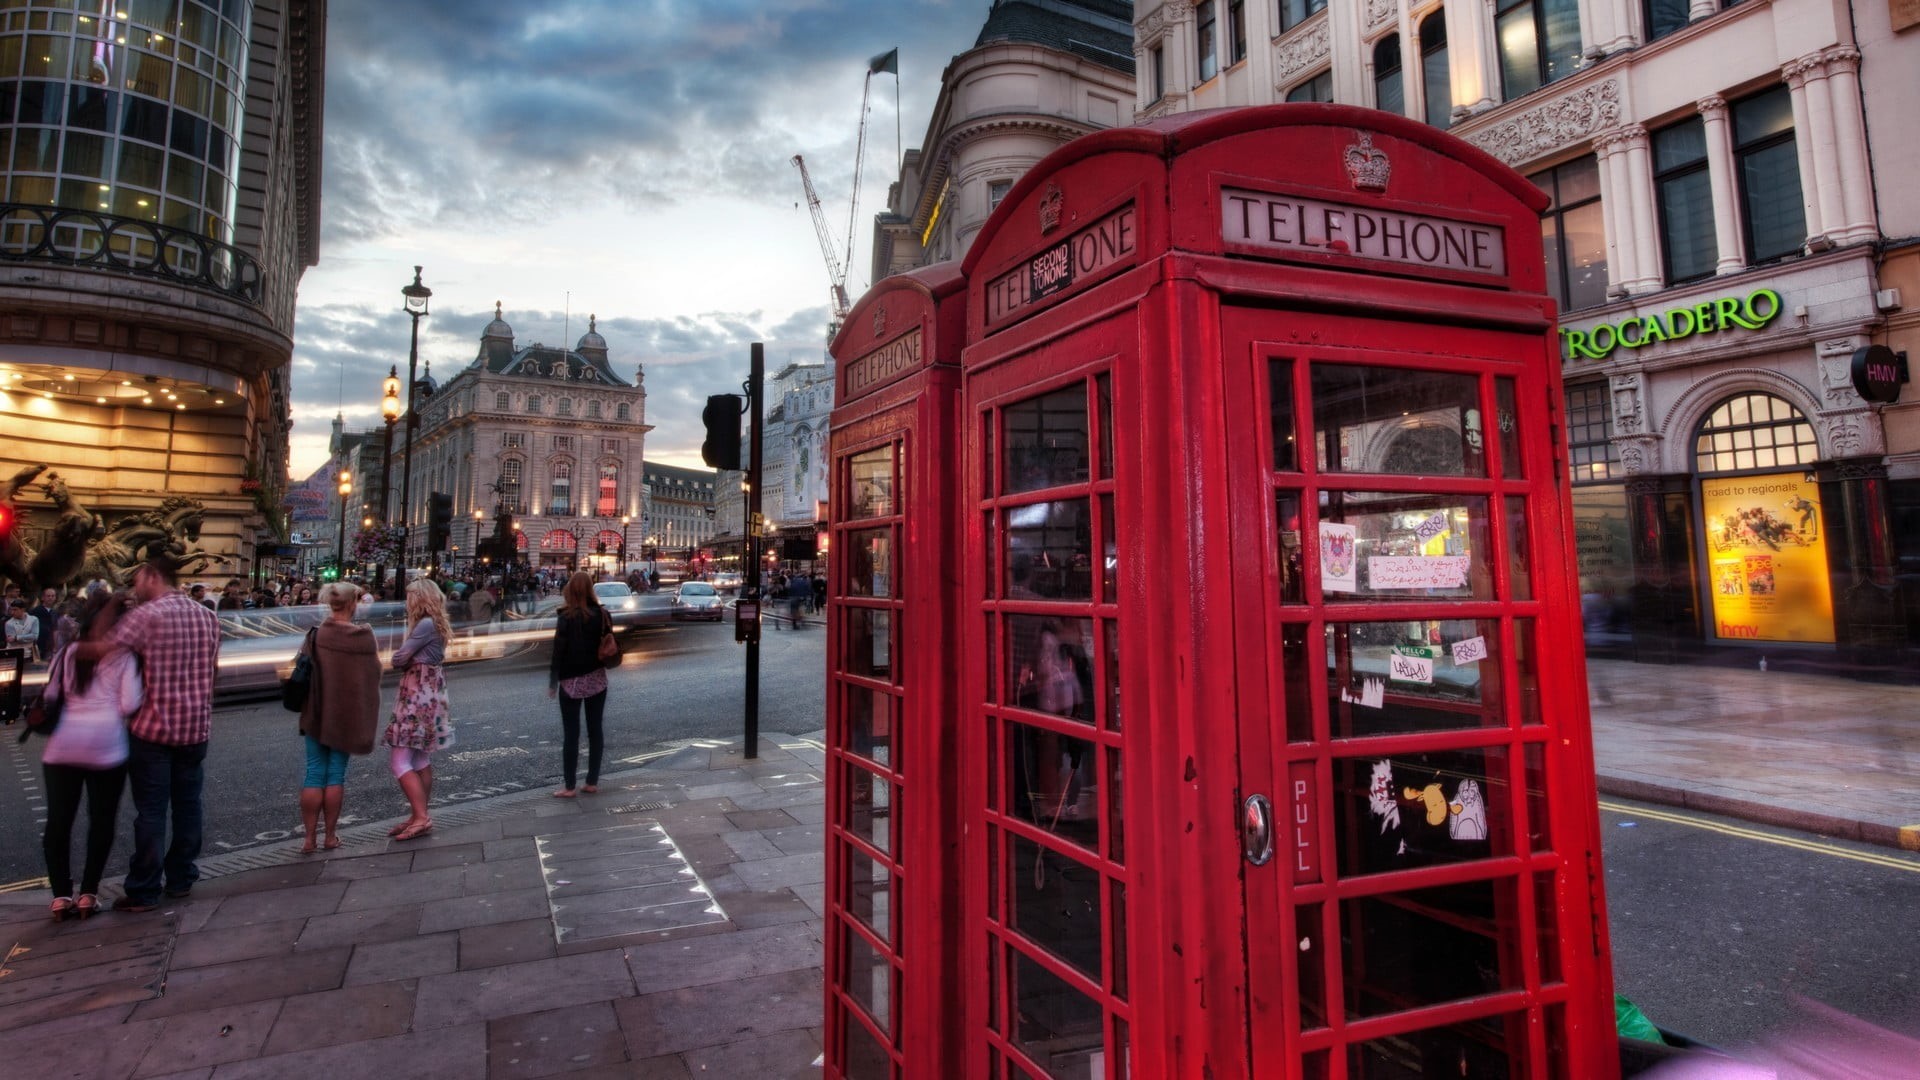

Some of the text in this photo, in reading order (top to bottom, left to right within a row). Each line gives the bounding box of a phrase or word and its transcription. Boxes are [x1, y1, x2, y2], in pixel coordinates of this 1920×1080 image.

[1229, 196, 1493, 269] TELEPHONE
[993, 209, 1134, 316] TELONE
[1033, 243, 1068, 276] SECOND
[1558, 288, 1780, 360] ROCADERO
[850, 331, 921, 393] TELEPHONE
[1866, 362, 1897, 383] HMV
[1707, 482, 1798, 497] road to regionals
[1400, 647, 1425, 656] HELLO
[1720, 621, 1759, 638] hmv
[1295, 780, 1311, 871] PULL
